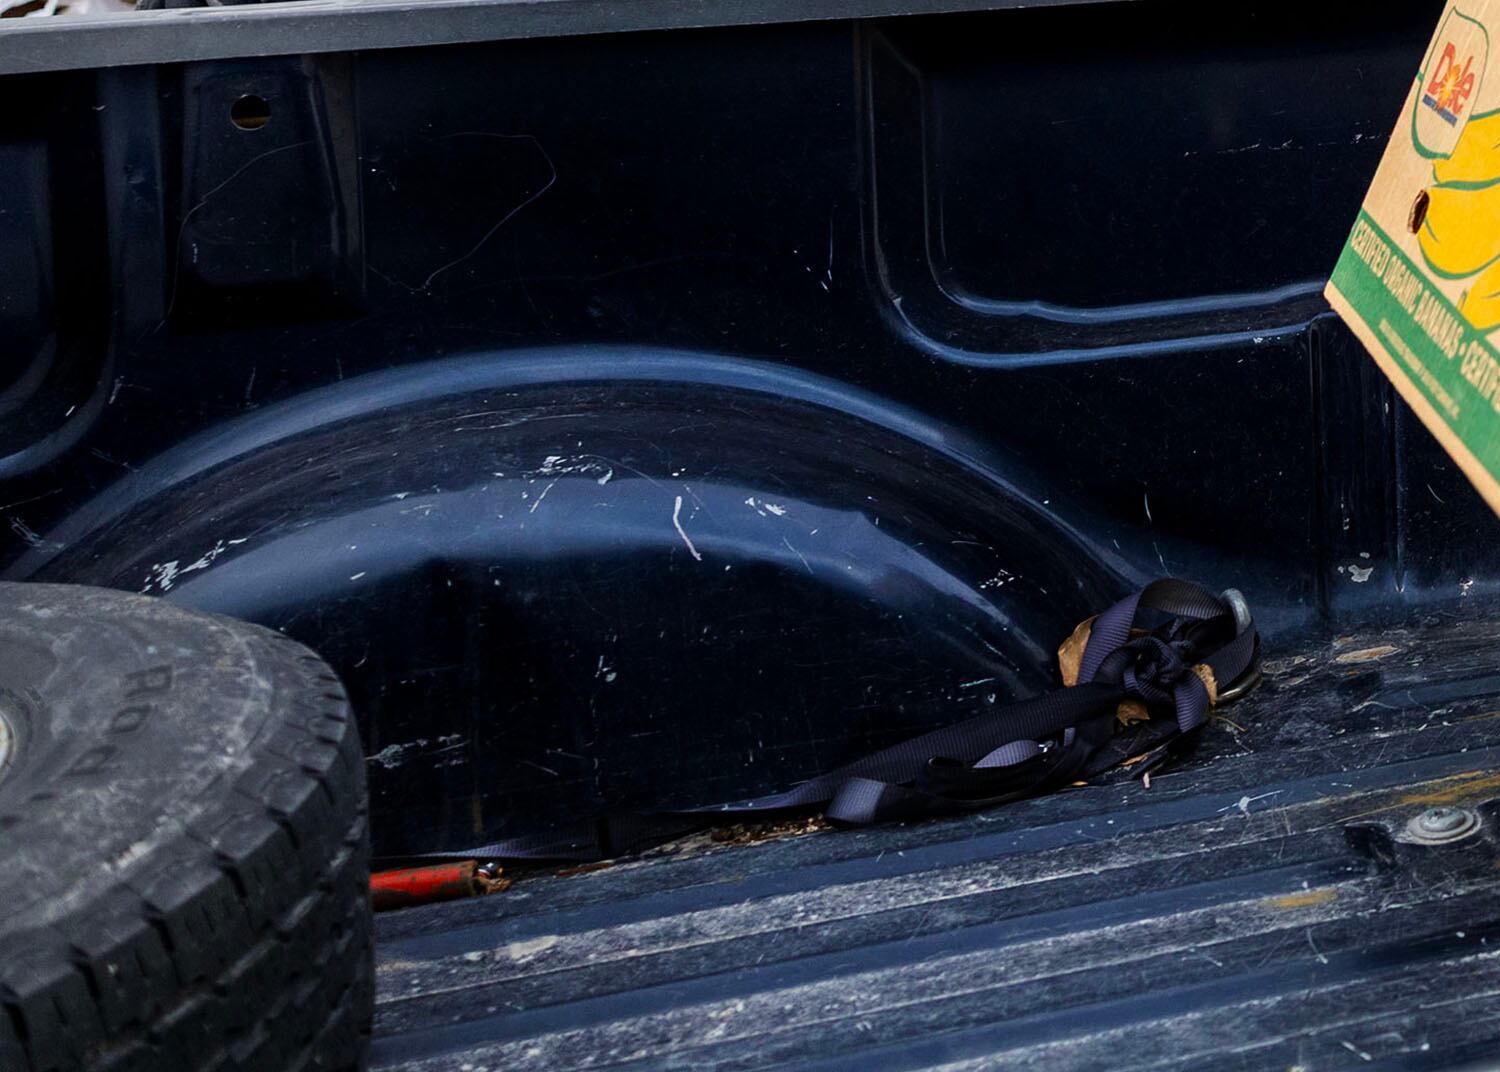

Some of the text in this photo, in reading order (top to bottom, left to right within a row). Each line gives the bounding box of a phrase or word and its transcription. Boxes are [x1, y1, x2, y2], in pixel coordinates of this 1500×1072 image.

[1427, 41, 1475, 115] Dole
[1351, 218, 1392, 278] CERTIFIED
[1382, 254, 1424, 316] ORGANIC
[1413, 289, 1465, 360] BANANAS
